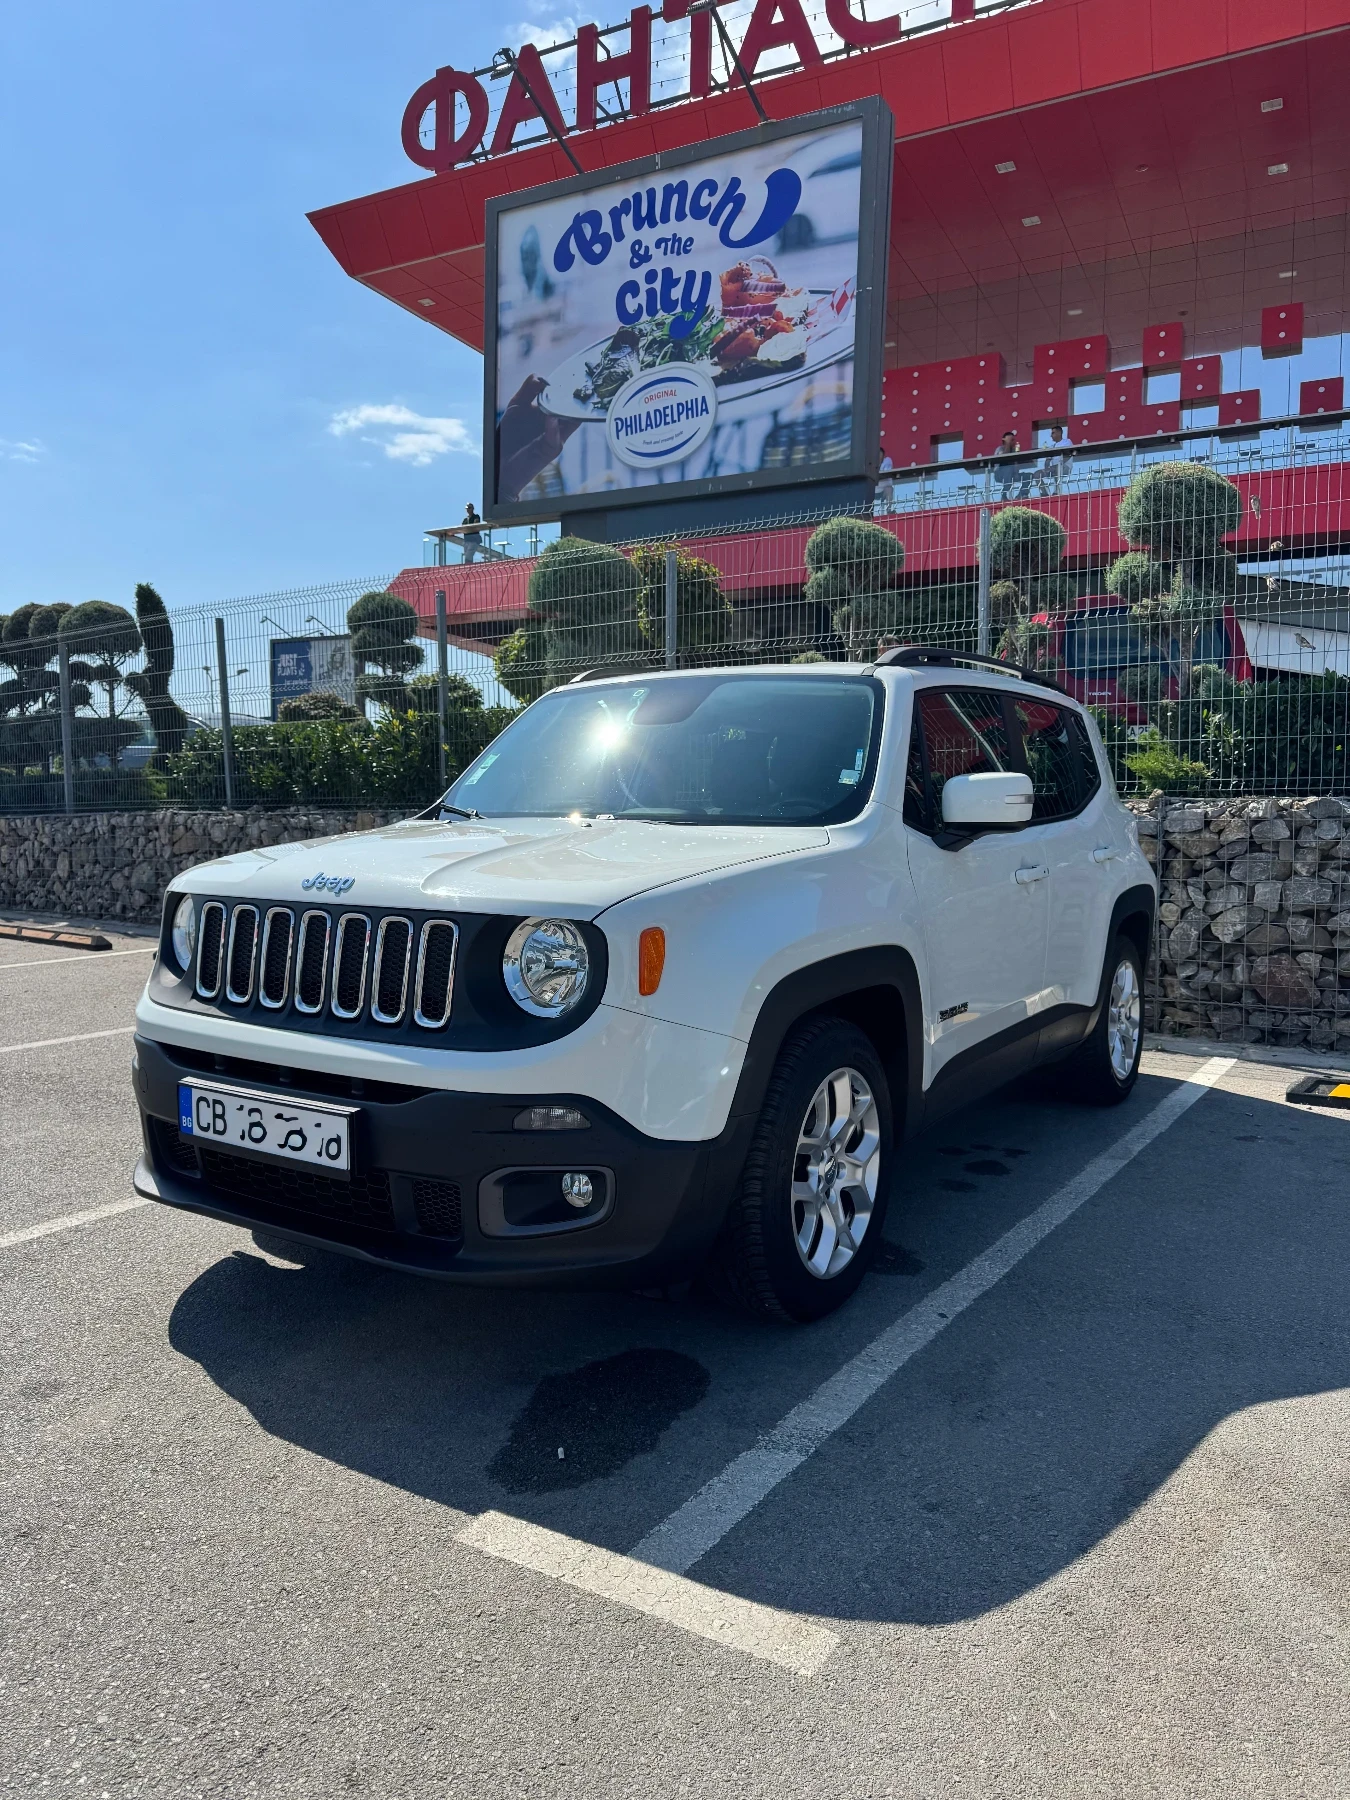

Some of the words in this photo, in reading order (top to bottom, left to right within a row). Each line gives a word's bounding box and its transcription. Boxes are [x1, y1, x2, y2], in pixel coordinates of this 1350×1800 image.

[553, 168, 802, 272] Brunch
[629, 239, 653, 269] &
[655, 233, 694, 256] The
[644, 389, 678, 404] ORIGINAL
[614, 395, 710, 440] PHILADELPHIA
[278, 653, 298, 667] JUST
[301, 871, 356, 897] Jeep
[182, 1115, 192, 1128] BG
